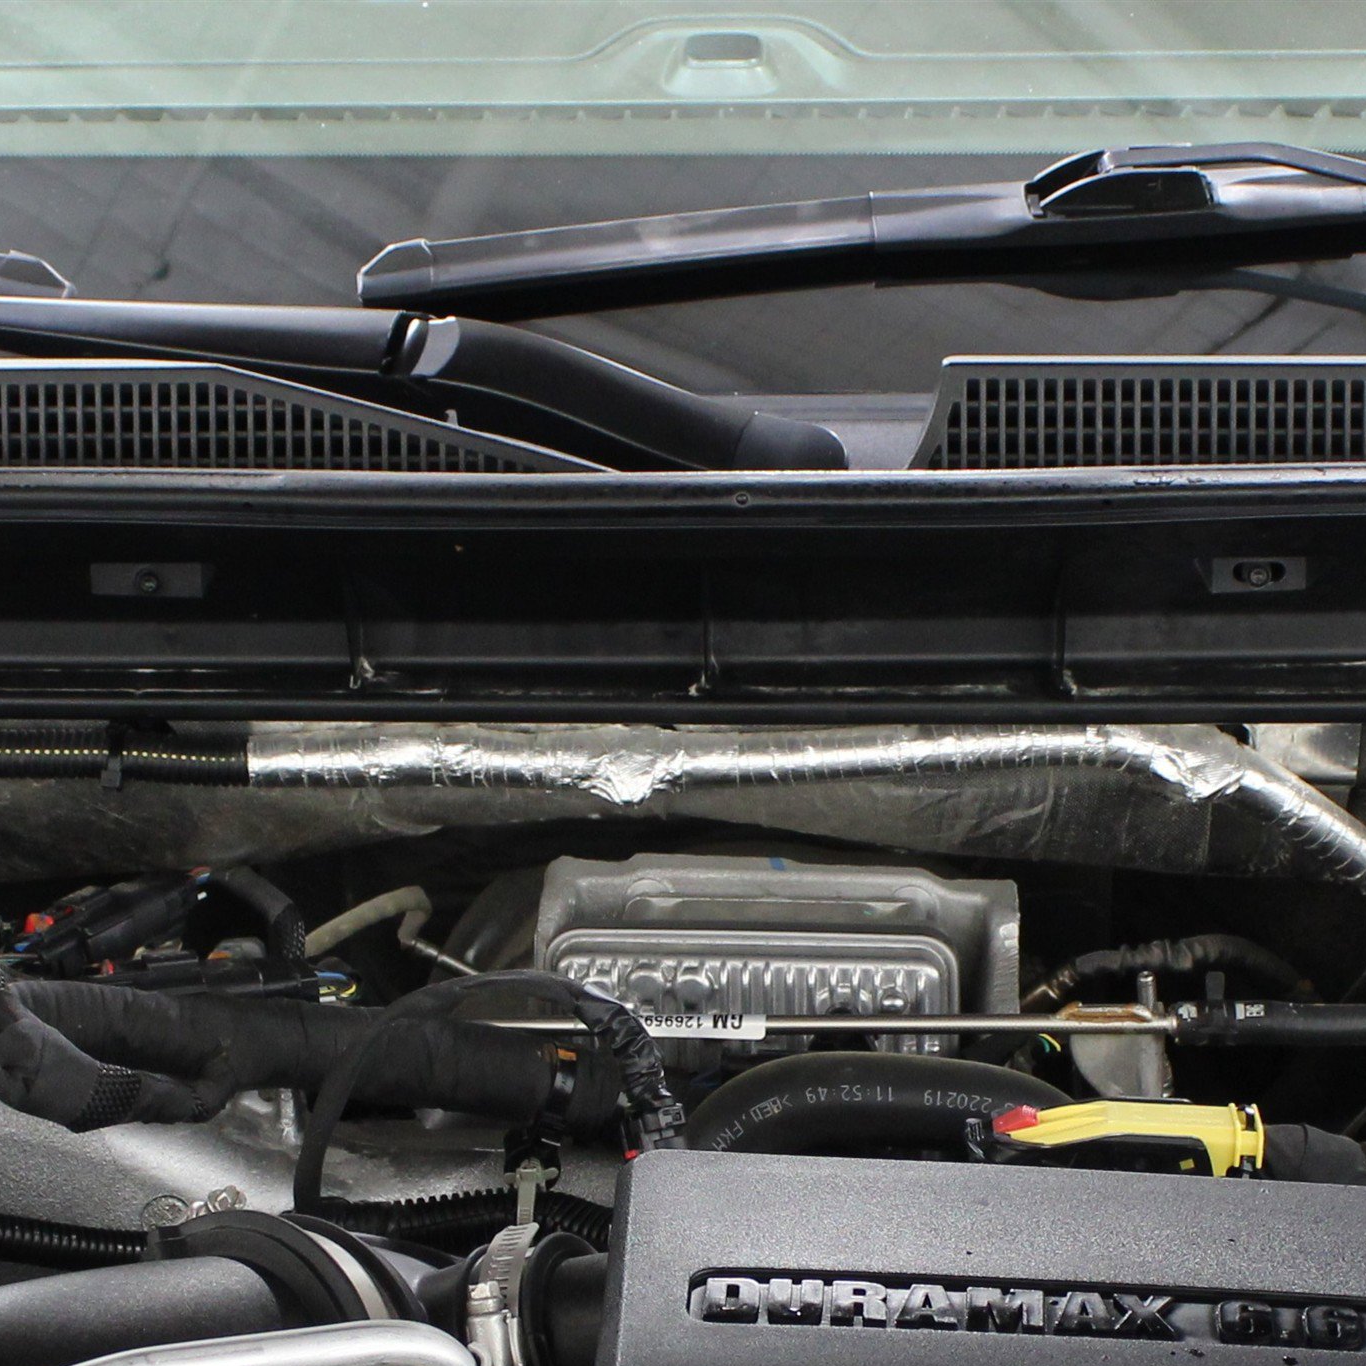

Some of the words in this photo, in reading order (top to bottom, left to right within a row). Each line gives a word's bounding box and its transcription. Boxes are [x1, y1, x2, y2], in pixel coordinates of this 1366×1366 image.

[713, 1014, 743, 1030] GM
[924, 1089, 992, 1114] 220219
[699, 1277, 1178, 1341] DURAMAX
[1215, 1299, 1364, 1350] 6.6
